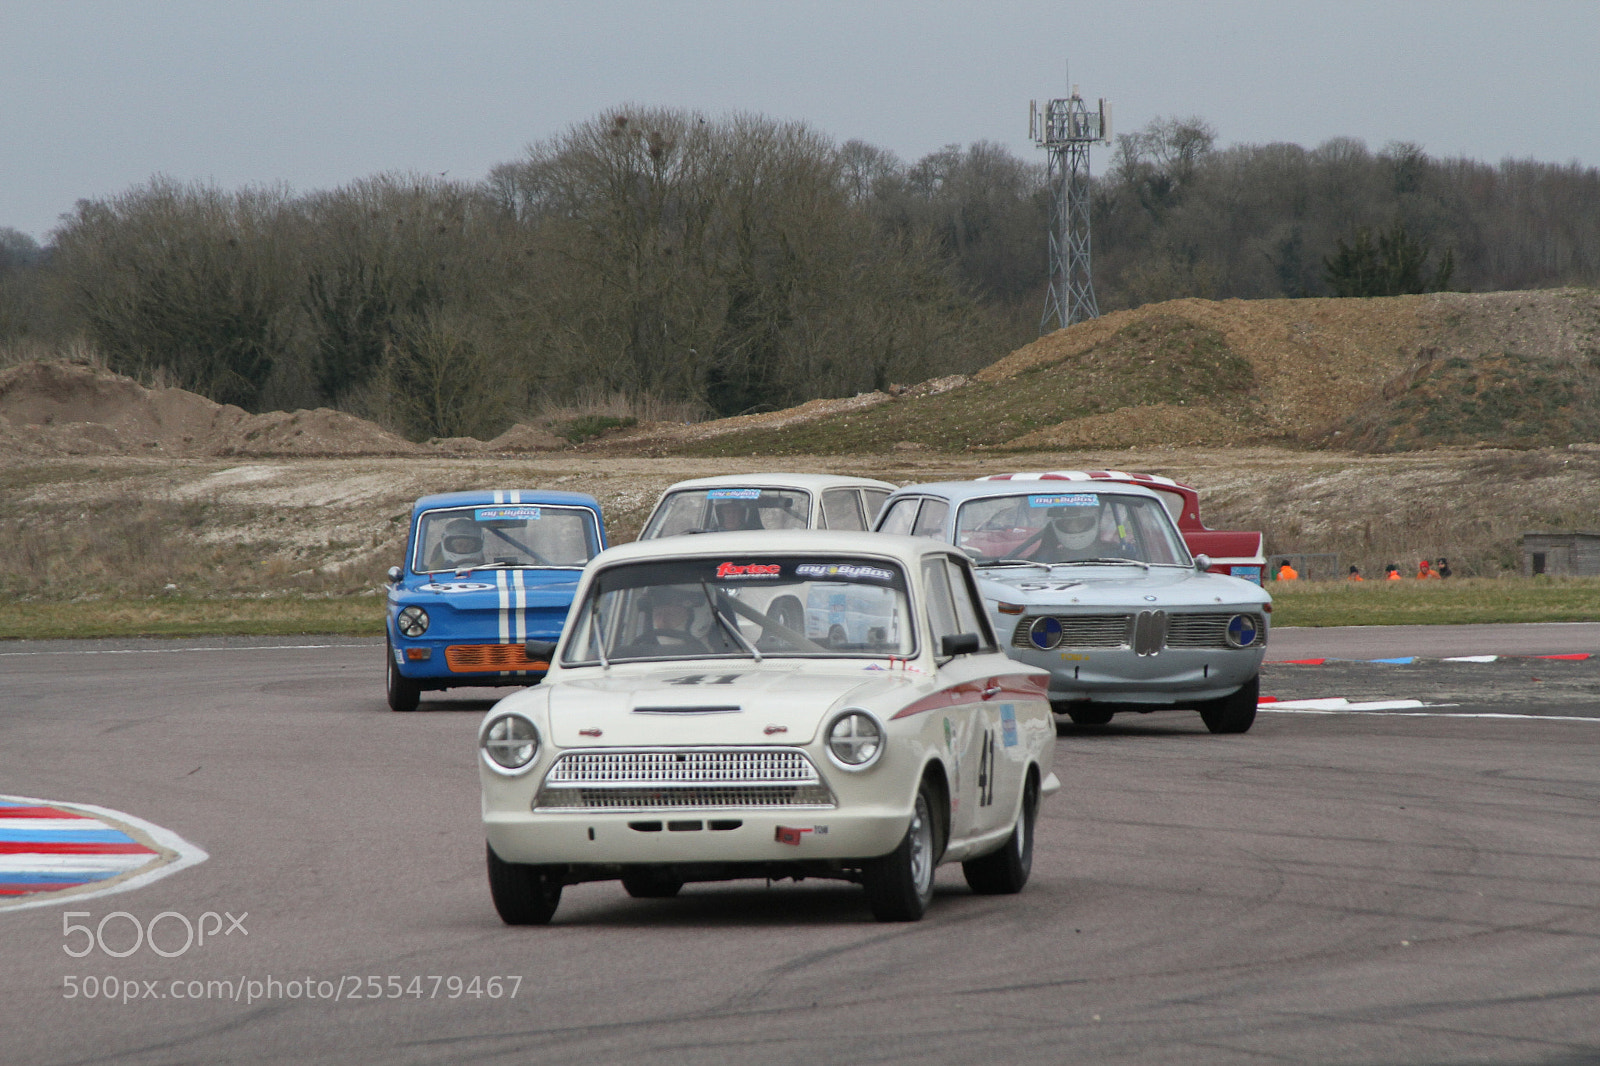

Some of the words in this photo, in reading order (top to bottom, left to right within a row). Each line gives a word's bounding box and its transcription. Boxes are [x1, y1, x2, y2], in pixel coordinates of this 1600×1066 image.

[716, 562, 781, 578] fortec
[661, 674, 743, 685] 41
[978, 729, 994, 807] 41
